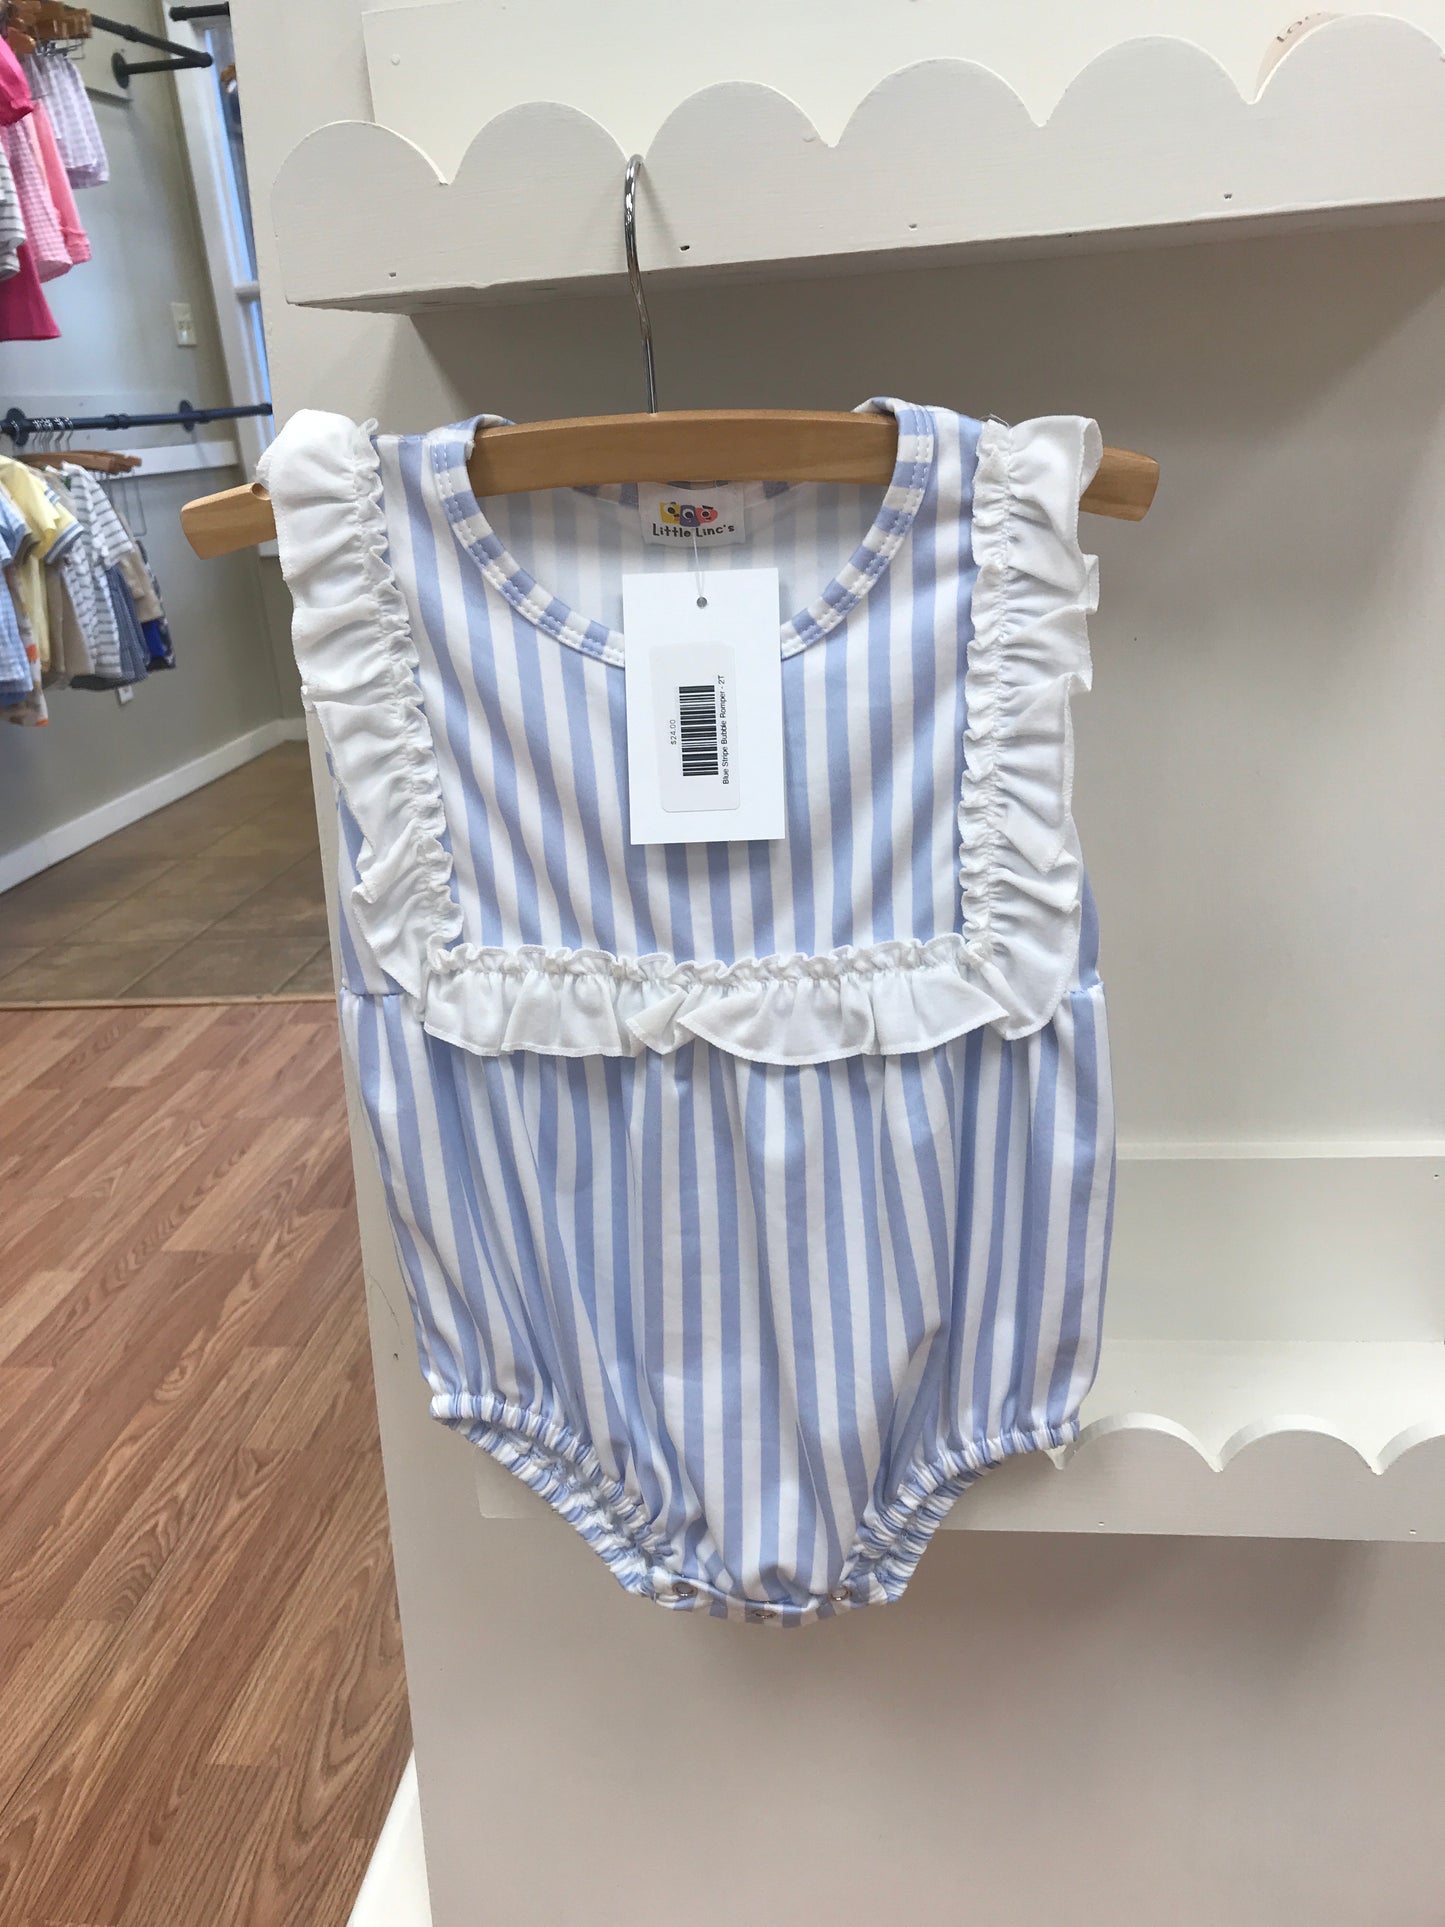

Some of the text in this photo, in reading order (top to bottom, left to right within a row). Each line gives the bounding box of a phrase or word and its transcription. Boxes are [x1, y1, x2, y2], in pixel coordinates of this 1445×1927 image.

[652, 523, 735, 538] Little Linc's
[718, 675, 725, 685] 2T
[669, 719, 677, 746] $24.00
